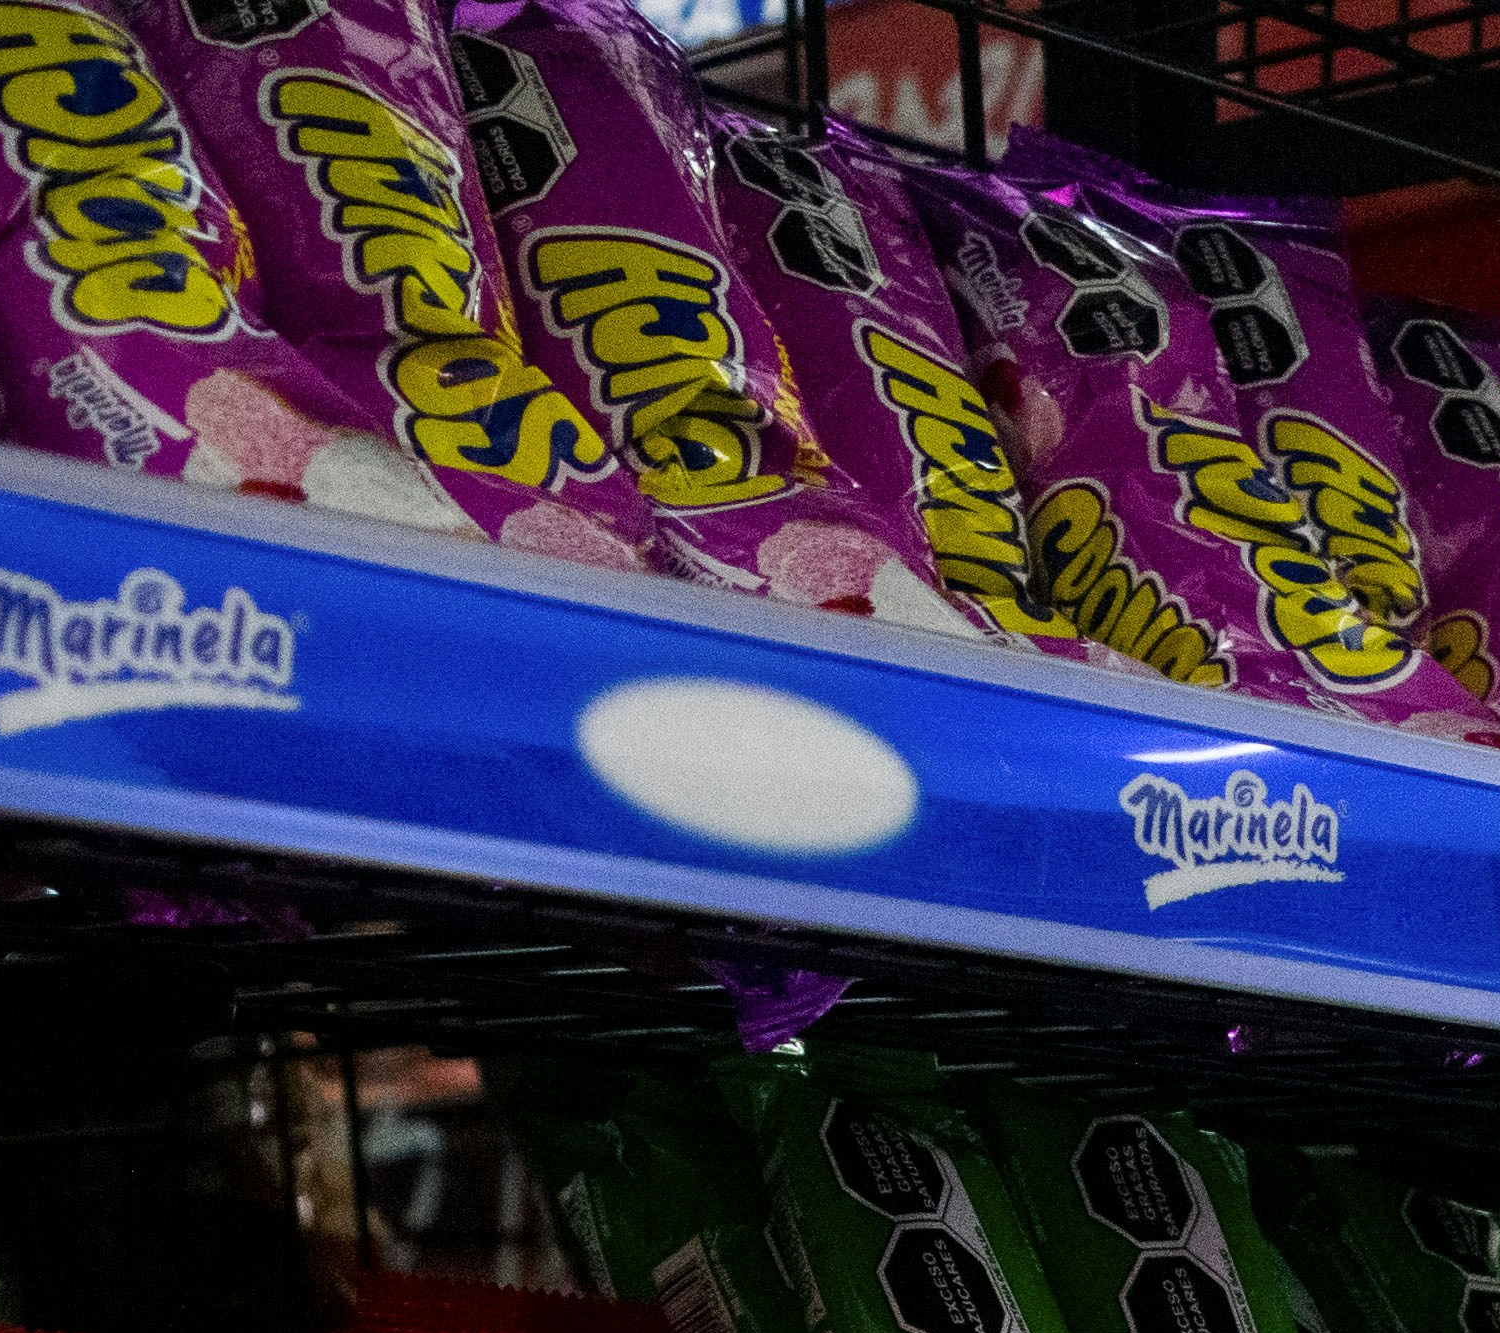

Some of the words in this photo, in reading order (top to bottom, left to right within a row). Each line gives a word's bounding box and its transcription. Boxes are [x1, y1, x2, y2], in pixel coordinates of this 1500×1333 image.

[1120, 772, 1342, 872] Marinela
[849, 1121, 895, 1198] EXCESO
[1104, 1144, 1140, 1222] EXCESO
[1121, 1143, 1158, 1223] GRASAS
[1132, 1125, 1181, 1240] SATURADAS
[920, 1250, 965, 1328] EXCESO
